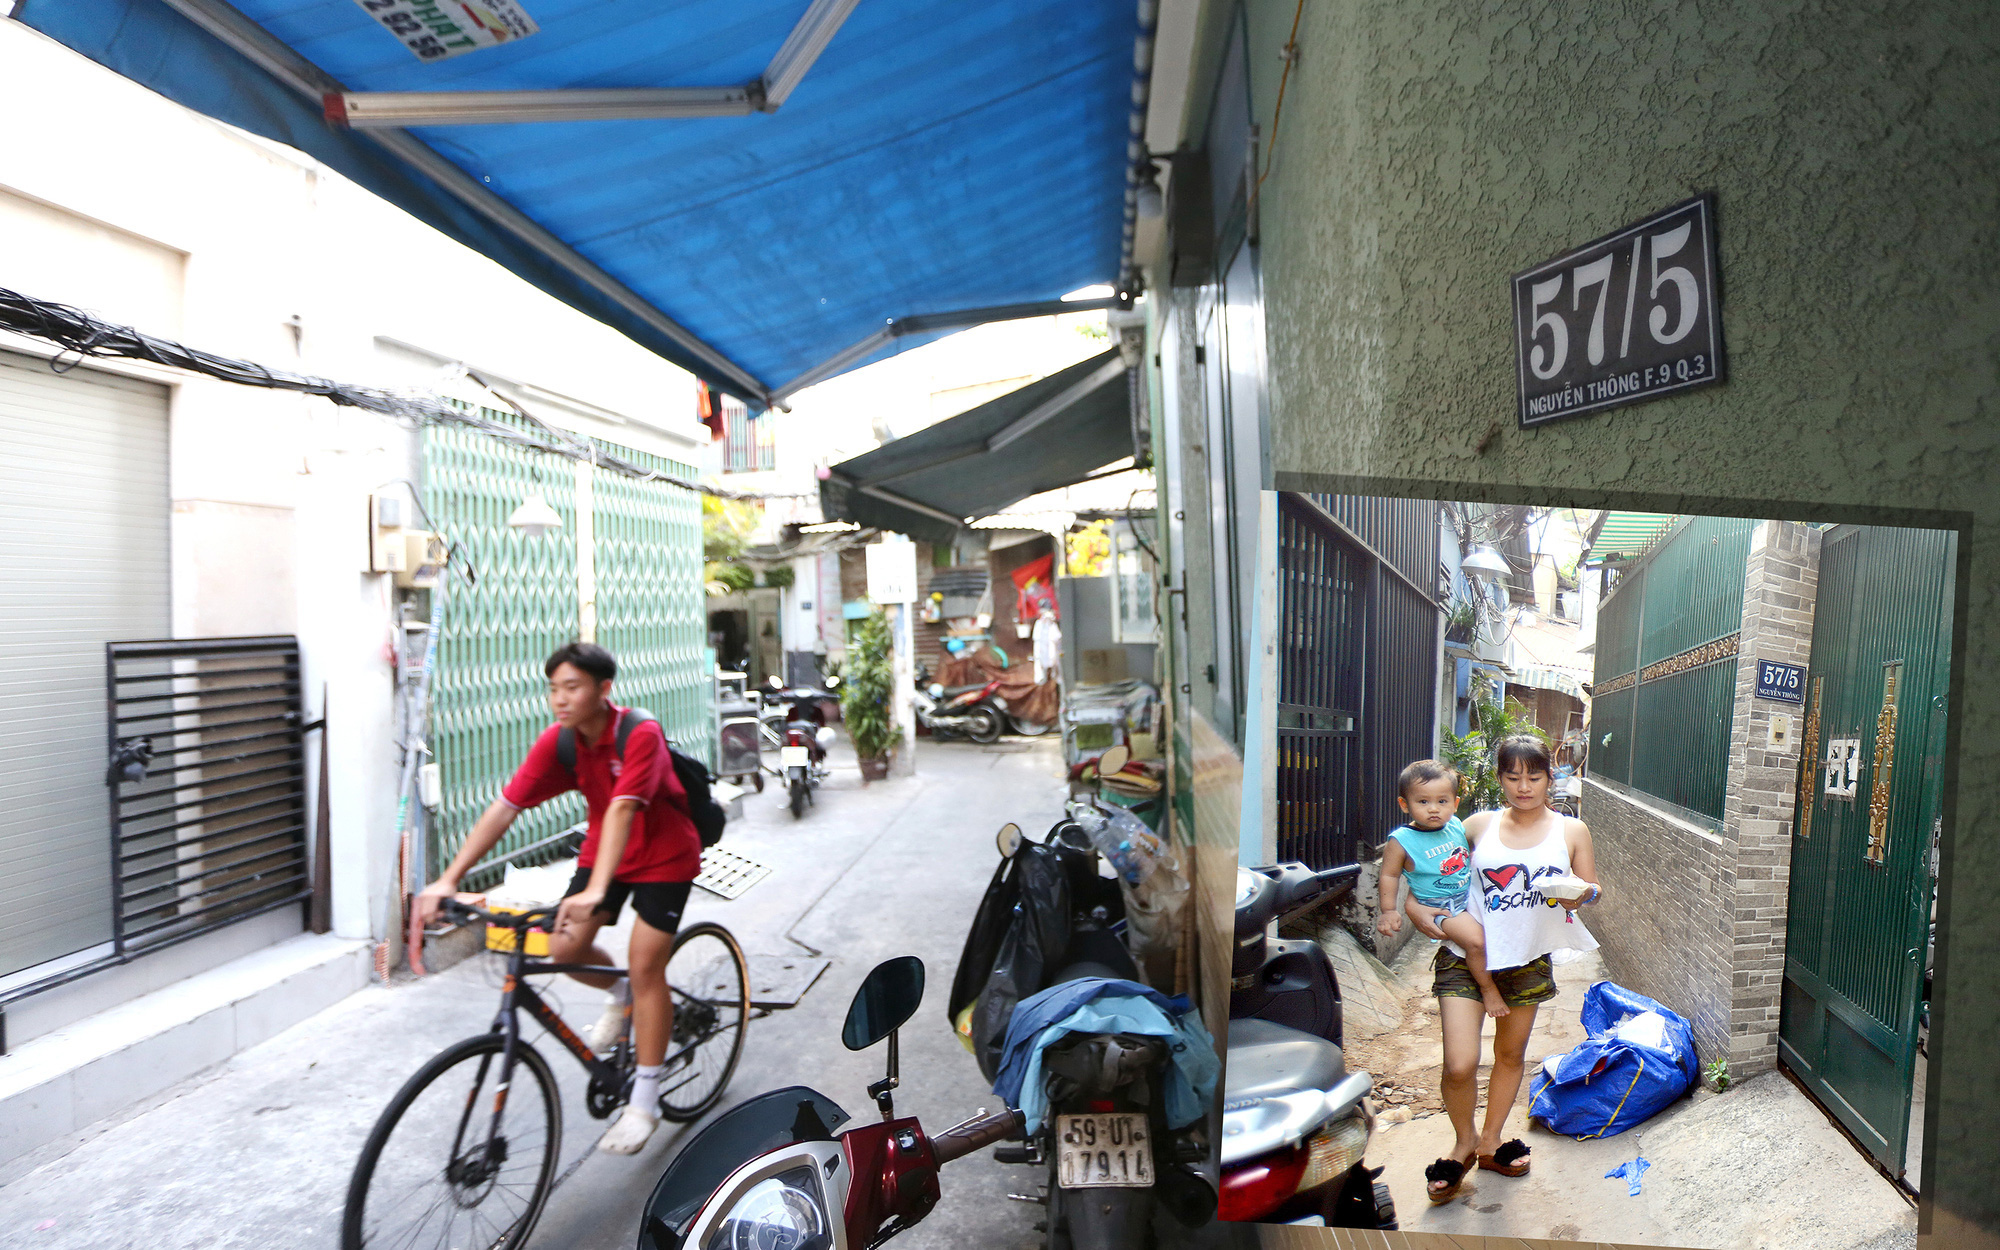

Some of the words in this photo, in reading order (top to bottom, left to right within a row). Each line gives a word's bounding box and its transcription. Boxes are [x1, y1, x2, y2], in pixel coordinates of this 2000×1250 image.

[1530, 220, 1700, 381] 57/5
[1529, 381, 1584, 416] NGUYỄN
[1587, 372, 1640, 401] THÔNG
[1644, 363, 1671, 388] F.9
[1676, 354, 1706, 381] Q.3
[1763, 665, 1799, 689] 57/5
